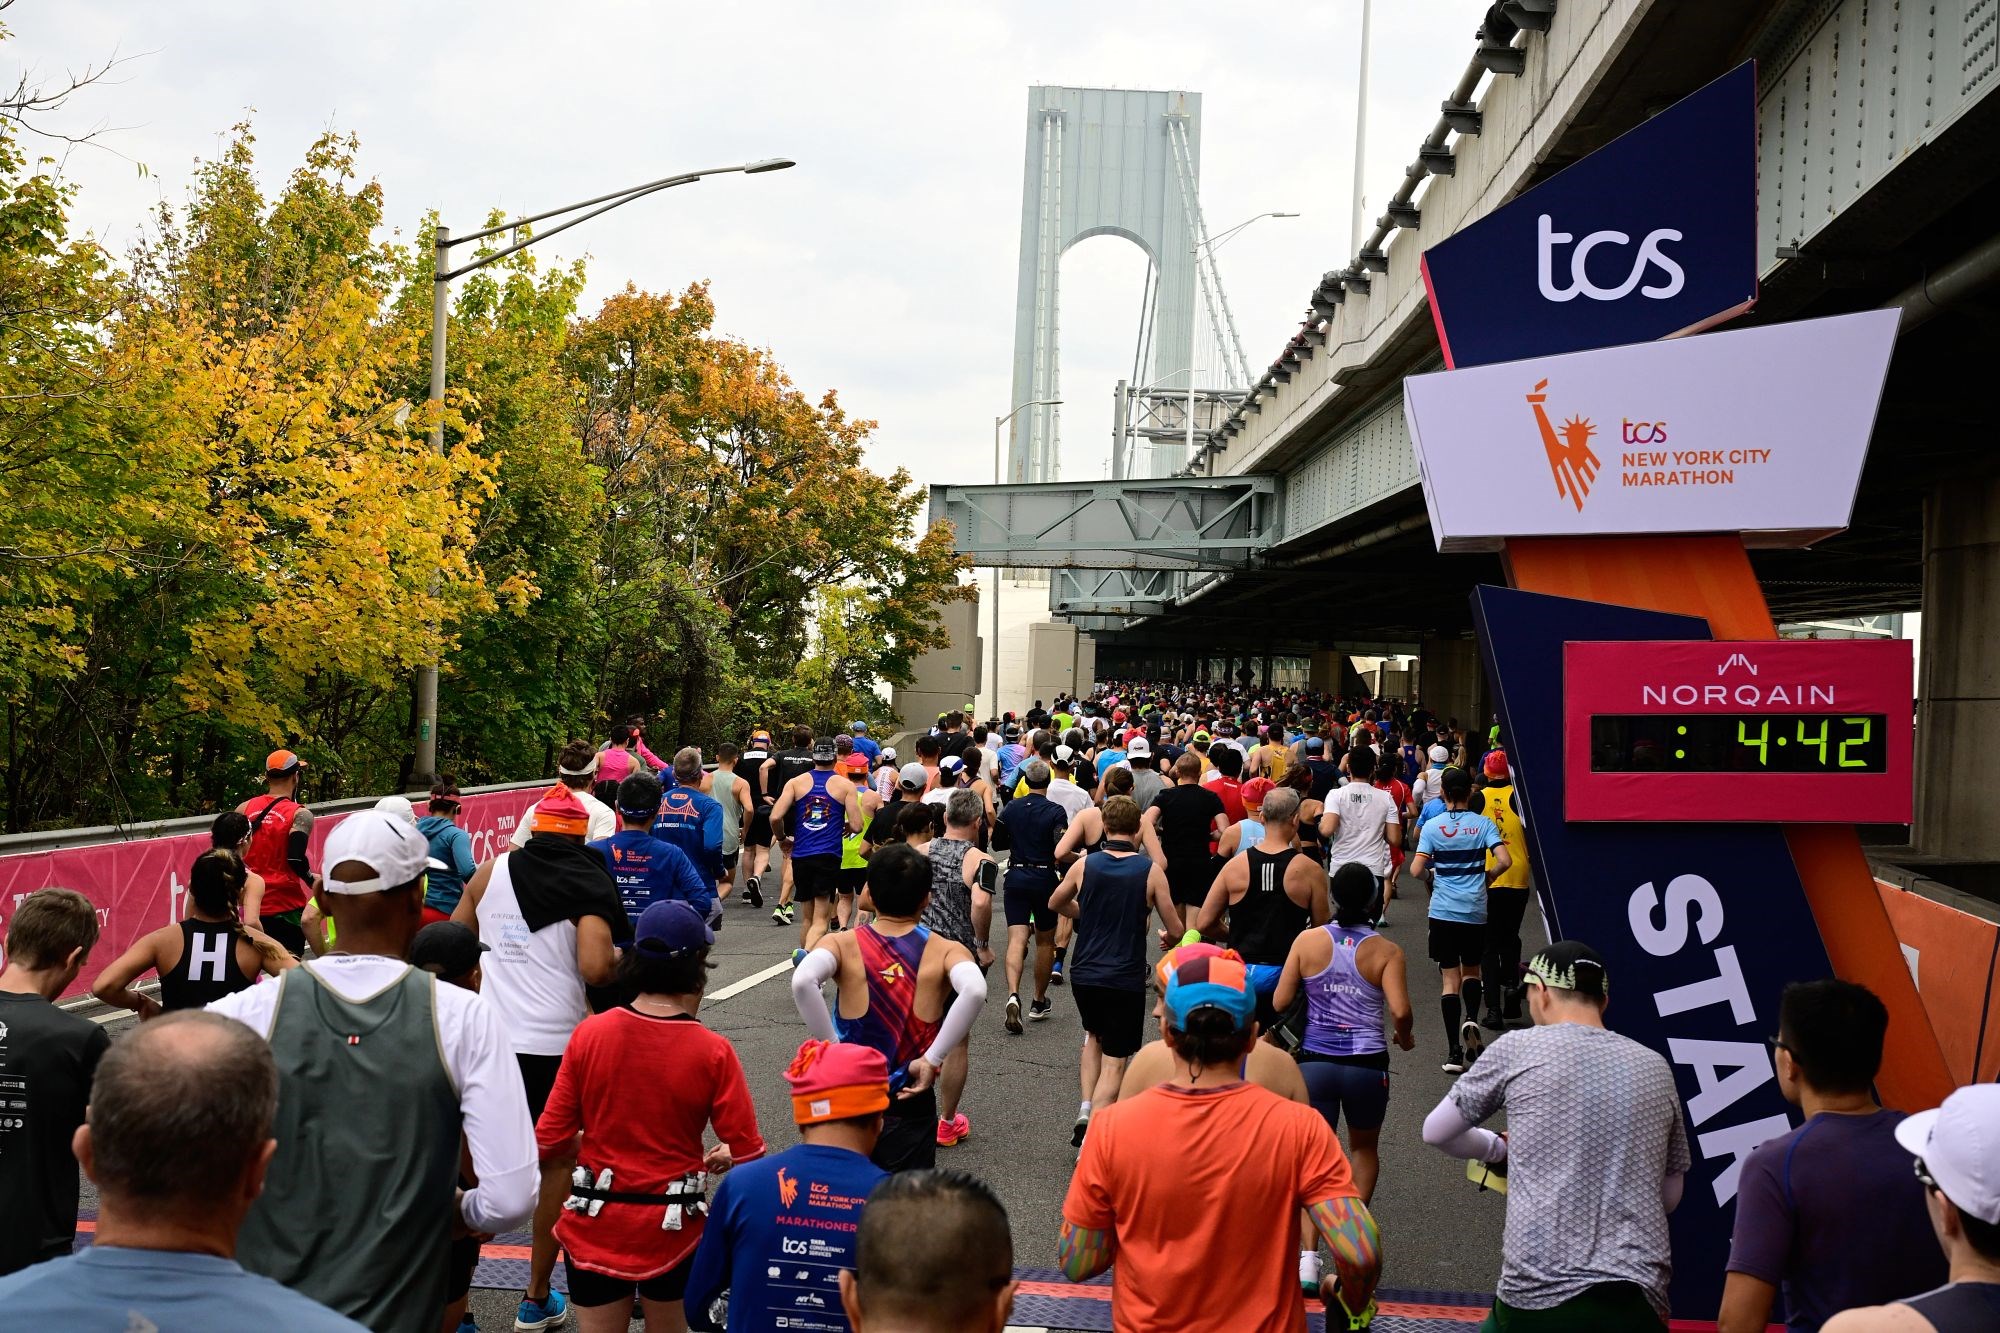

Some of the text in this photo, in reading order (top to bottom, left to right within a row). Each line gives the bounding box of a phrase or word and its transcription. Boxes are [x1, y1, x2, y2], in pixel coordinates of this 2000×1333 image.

[1538, 214, 1685, 302] tcs
[1622, 417, 1667, 444] tcs
[1622, 449, 1771, 467] NEW YORK CITY
[1622, 470, 1734, 487] MARATHON
[1643, 685, 1834, 706] NORQAIN
[497, 816, 515, 830] TATA
[188, 932, 228, 981] H
[1323, 983, 1362, 995] LUPITA
[1628, 874, 1791, 1208] STAR
[811, 1182, 829, 1193] tcs
[809, 1200, 852, 1210] MARATHON
[829, 1195, 849, 1203] YORK
[776, 1215, 858, 1232] MARATHONER
[783, 1236, 807, 1254] tcs
